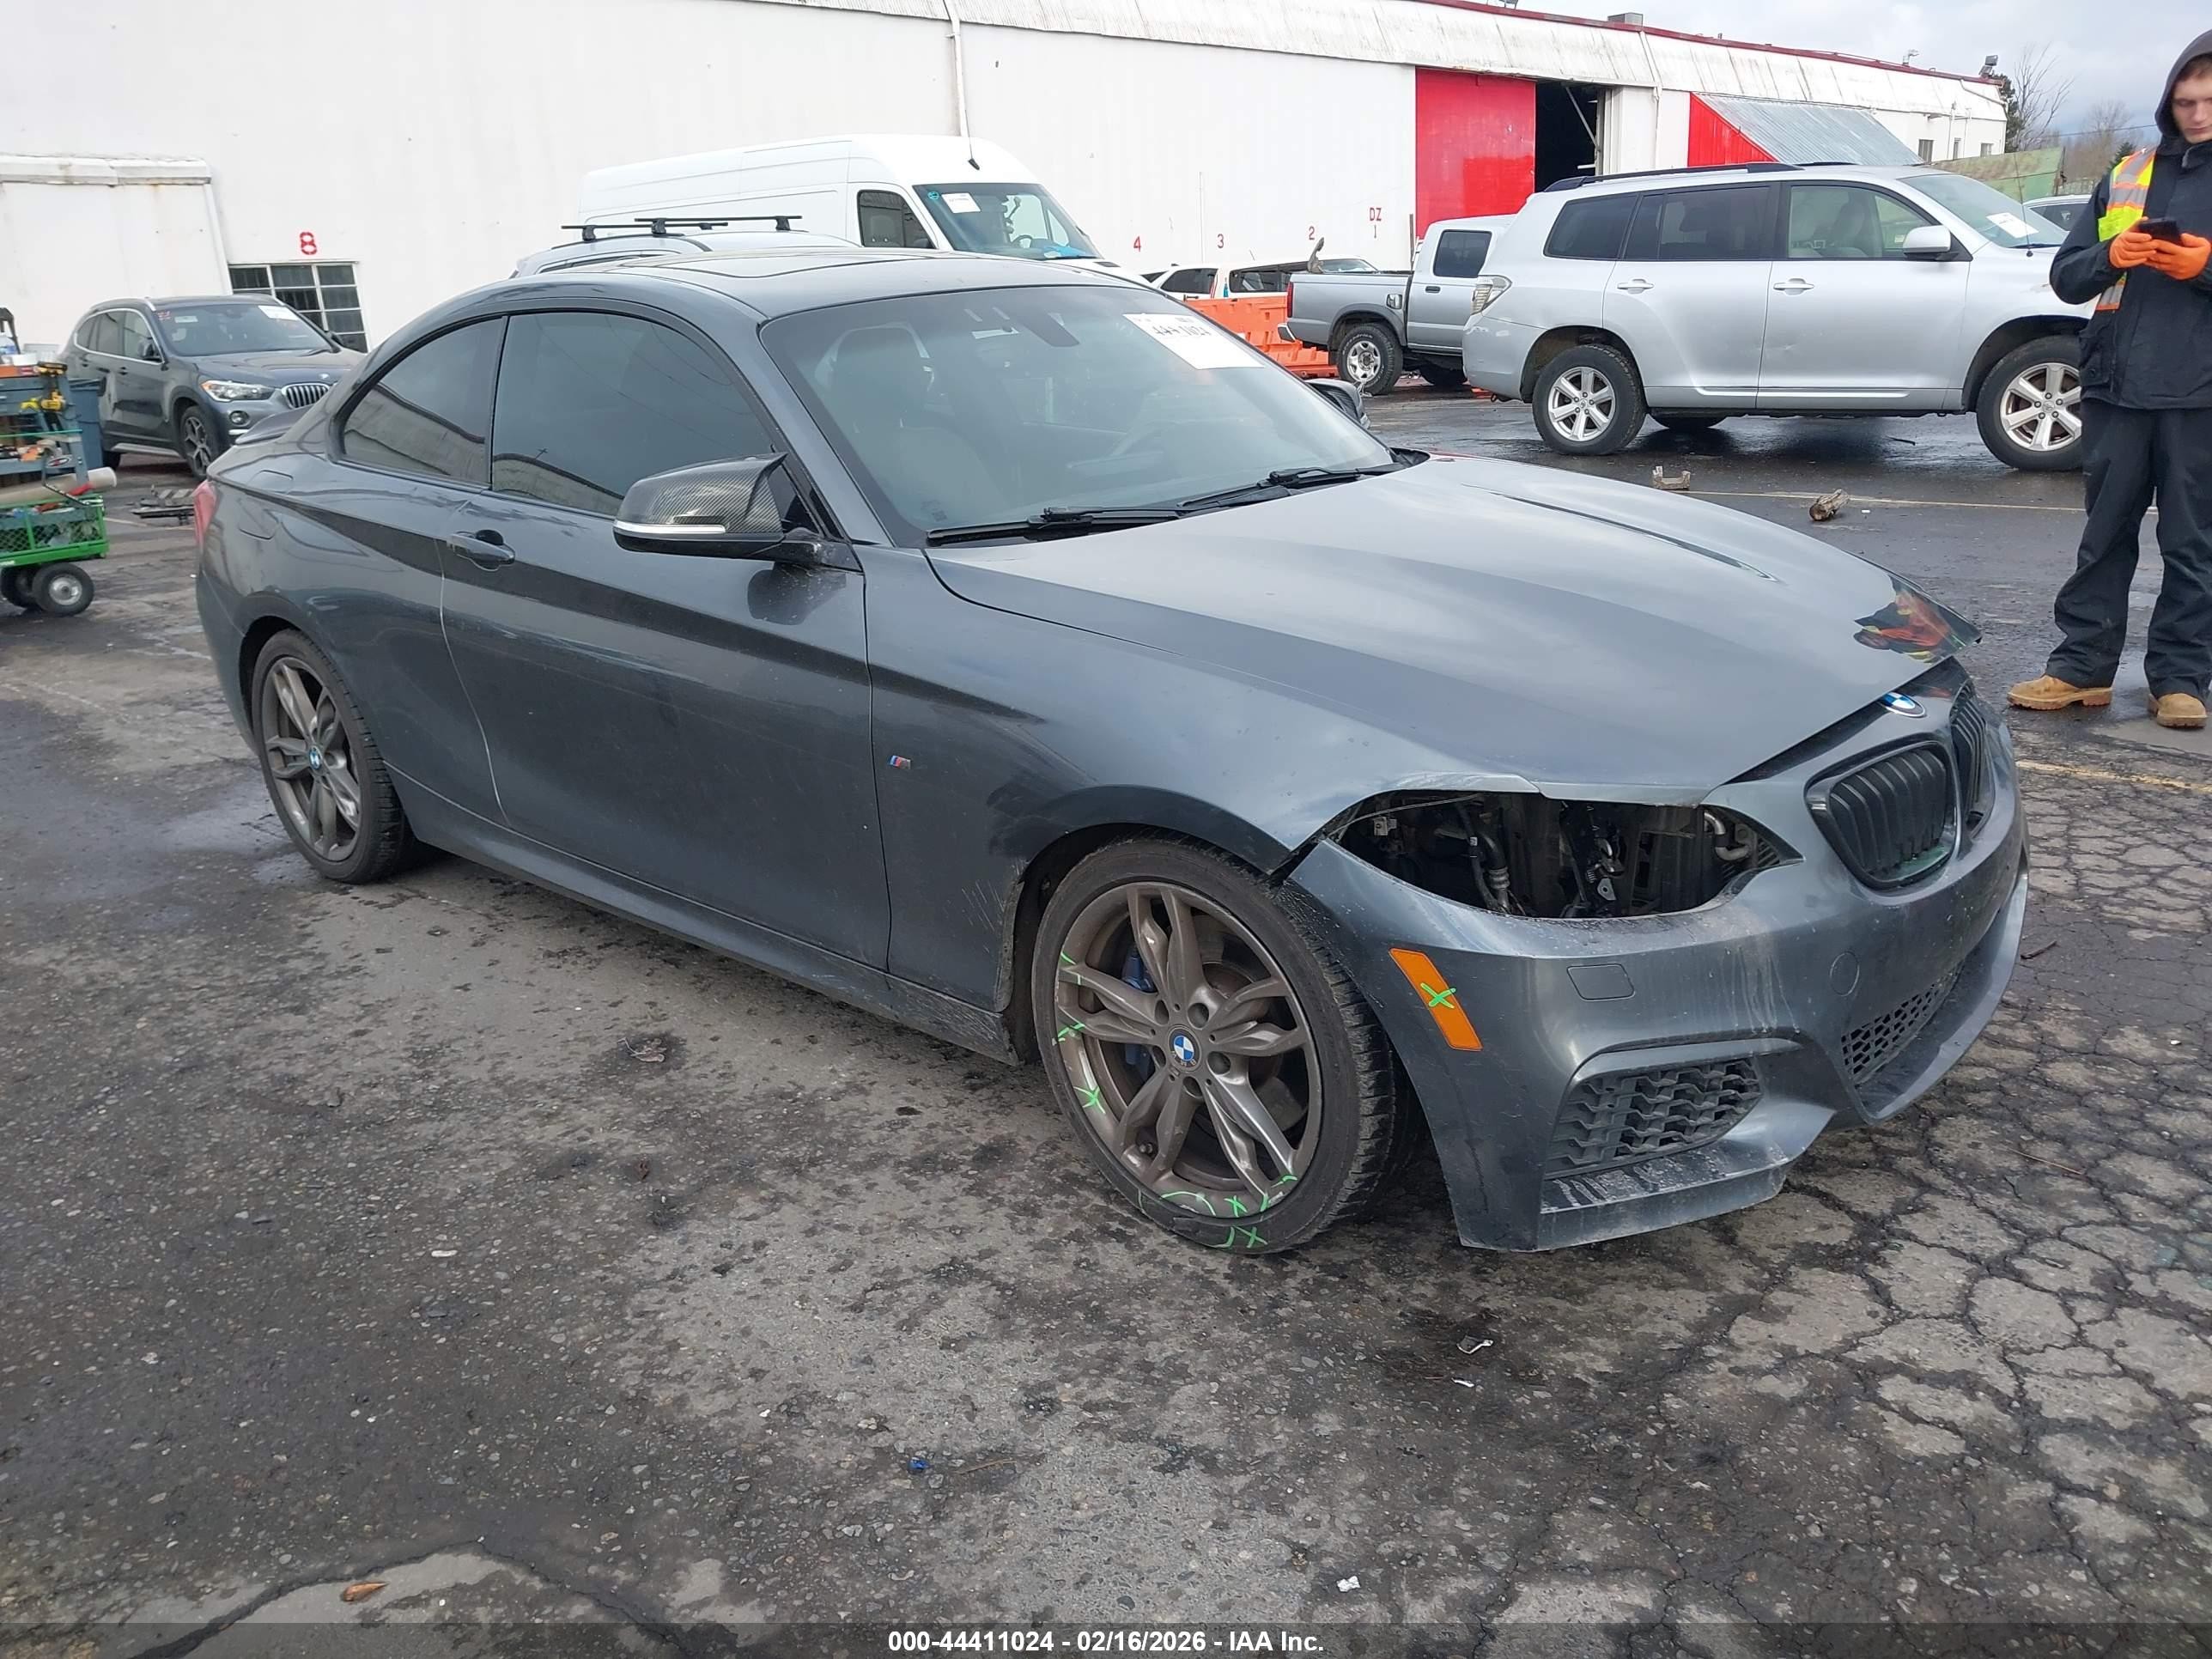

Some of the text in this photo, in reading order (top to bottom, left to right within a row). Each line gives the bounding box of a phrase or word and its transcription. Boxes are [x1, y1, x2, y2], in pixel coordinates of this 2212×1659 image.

[1369, 207, 1382, 222] DZ
[1308, 225, 1316, 240] 2
[300, 231, 318, 256] 8
[1133, 235, 1142, 252] 4
[1217, 233, 1224, 249] 3
